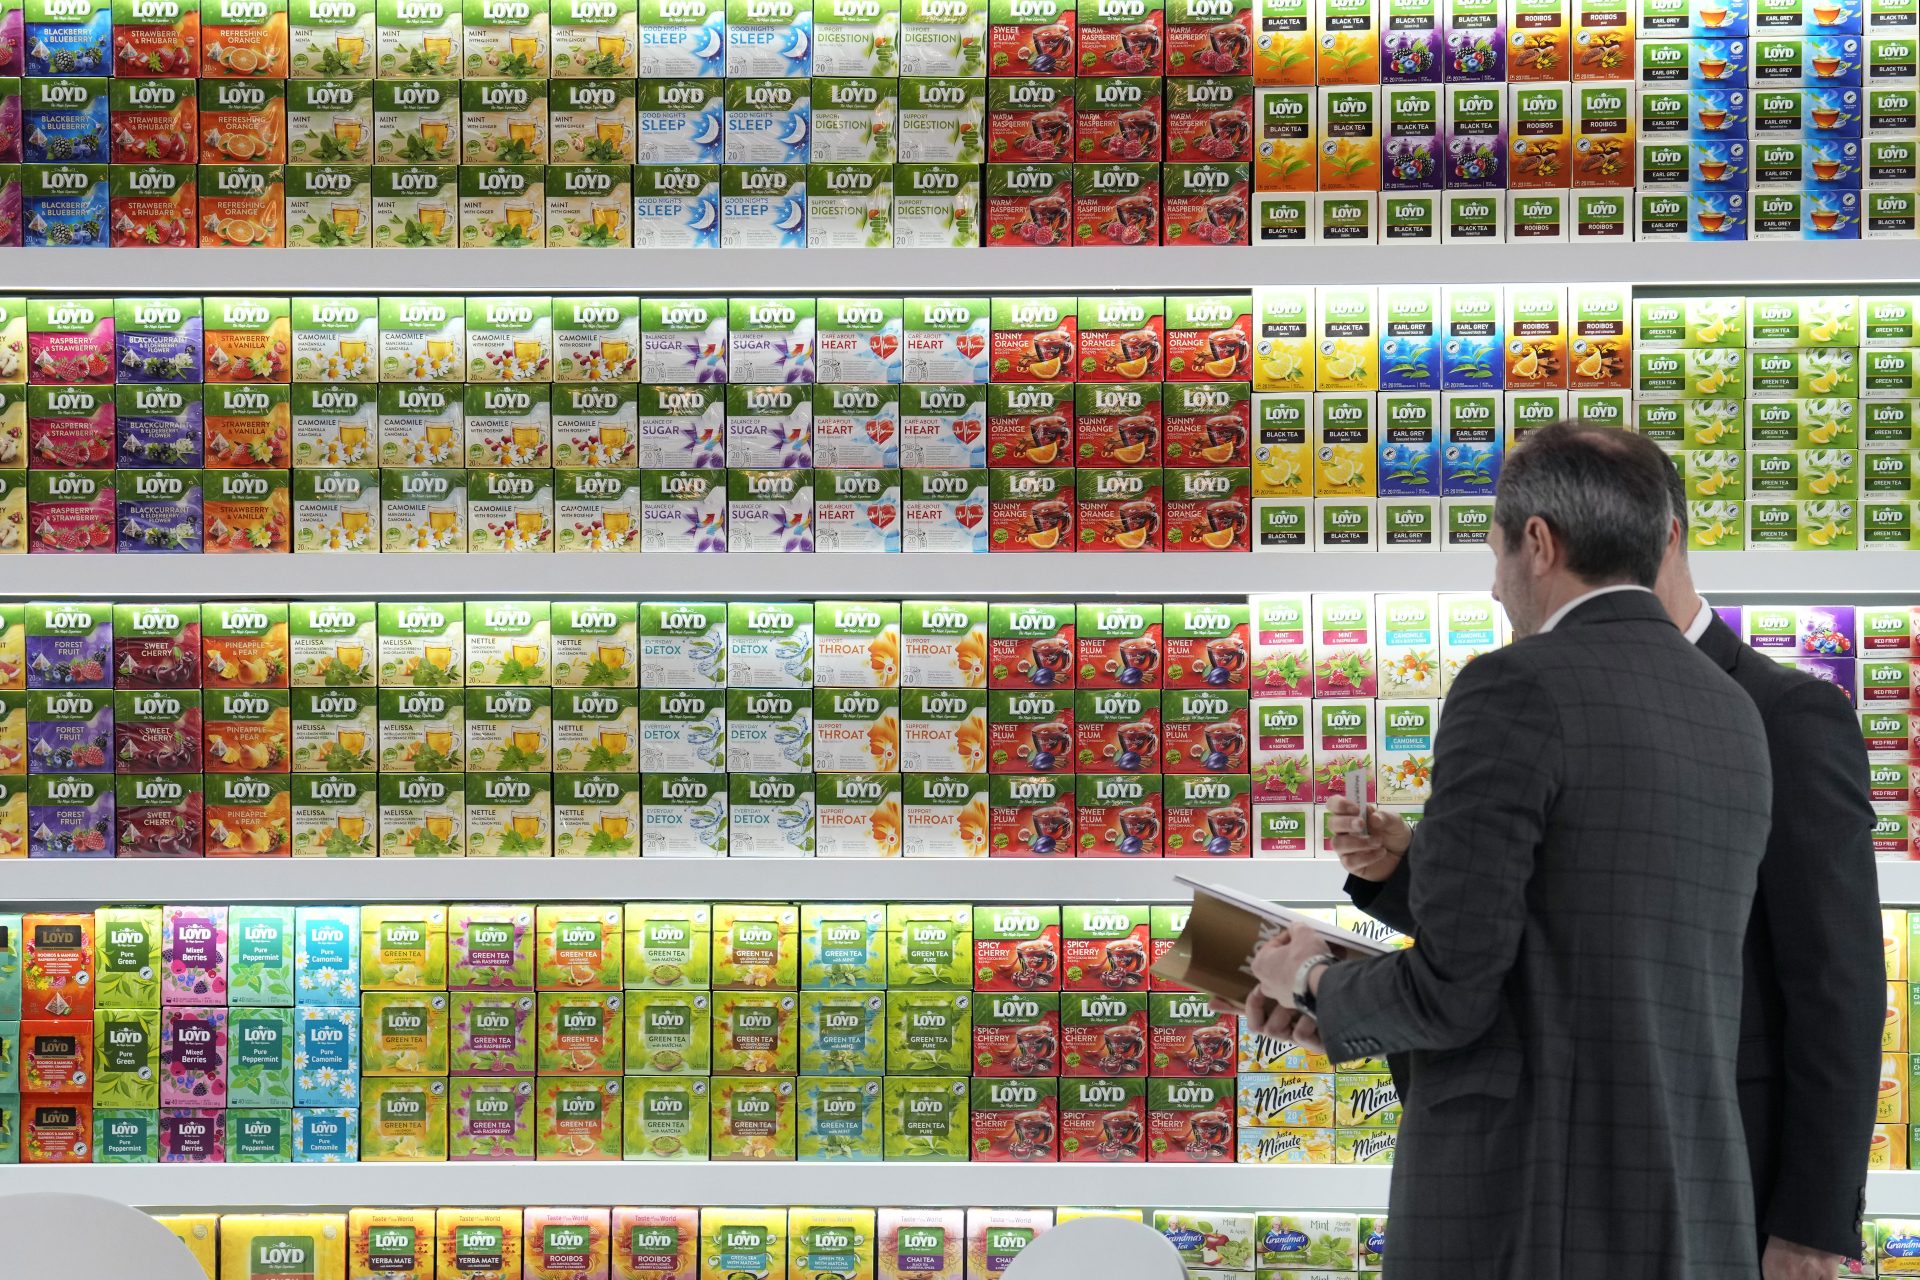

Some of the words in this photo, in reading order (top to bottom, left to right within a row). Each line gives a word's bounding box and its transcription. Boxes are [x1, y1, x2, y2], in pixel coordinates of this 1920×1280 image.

[131, 30, 181, 38] STRAWBERRY
[220, 30, 268, 38] REFRESHING
[1880, 47, 1909, 59] LOYD
[42, 86, 87, 103] LOYD
[219, 86, 264, 104] LOYD
[658, 87, 703, 104] LOYD
[1009, 86, 1055, 103] LOYD
[1397, 100, 1430, 114] LOYD
[1523, 99, 1557, 112] LOYD
[642, 120, 685, 131] SLEEP
[904, 121, 955, 129] DIGESTION
[993, 120, 1029, 128] RASPBERRY
[901, 151, 911, 160] 20
[392, 173, 437, 191] LOYD
[223, 307, 270, 324] LOYD
[662, 307, 707, 325] LOYD
[1187, 306, 1232, 324] LOYD
[646, 341, 682, 350] SUGAR
[908, 340, 942, 350] HEART
[1393, 407, 1426, 420] LOYD
[136, 478, 181, 495] LOYD
[46, 611, 91, 629] LOYD
[835, 611, 880, 628] LOYD
[819, 645, 864, 654] THROAT
[817, 674, 826, 683] 20
[134, 697, 179, 715] LOYD
[573, 697, 618, 714] LOYD
[1265, 714, 1298, 727] LOYD
[1870, 719, 1900, 731] LOYD
[644, 731, 680, 740] DETOX
[111, 931, 143, 943] LOYD
[245, 929, 277, 942] LOYD
[476, 930, 508, 942] LOYD
[978, 942, 1000, 950] SPICY
[243, 953, 279, 962] Peppermint
[312, 955, 342, 963] Camomile
[978, 949, 1010, 957] CHERRY
[914, 1015, 945, 1027] LOYD
[1280, 1077, 1296, 1088] Just
[1255, 1082, 1314, 1117] Minute
[1311, 1220, 1329, 1231] Mint
[1266, 1235, 1305, 1245] Grandma's
[260, 1248, 304, 1264] LOYD
